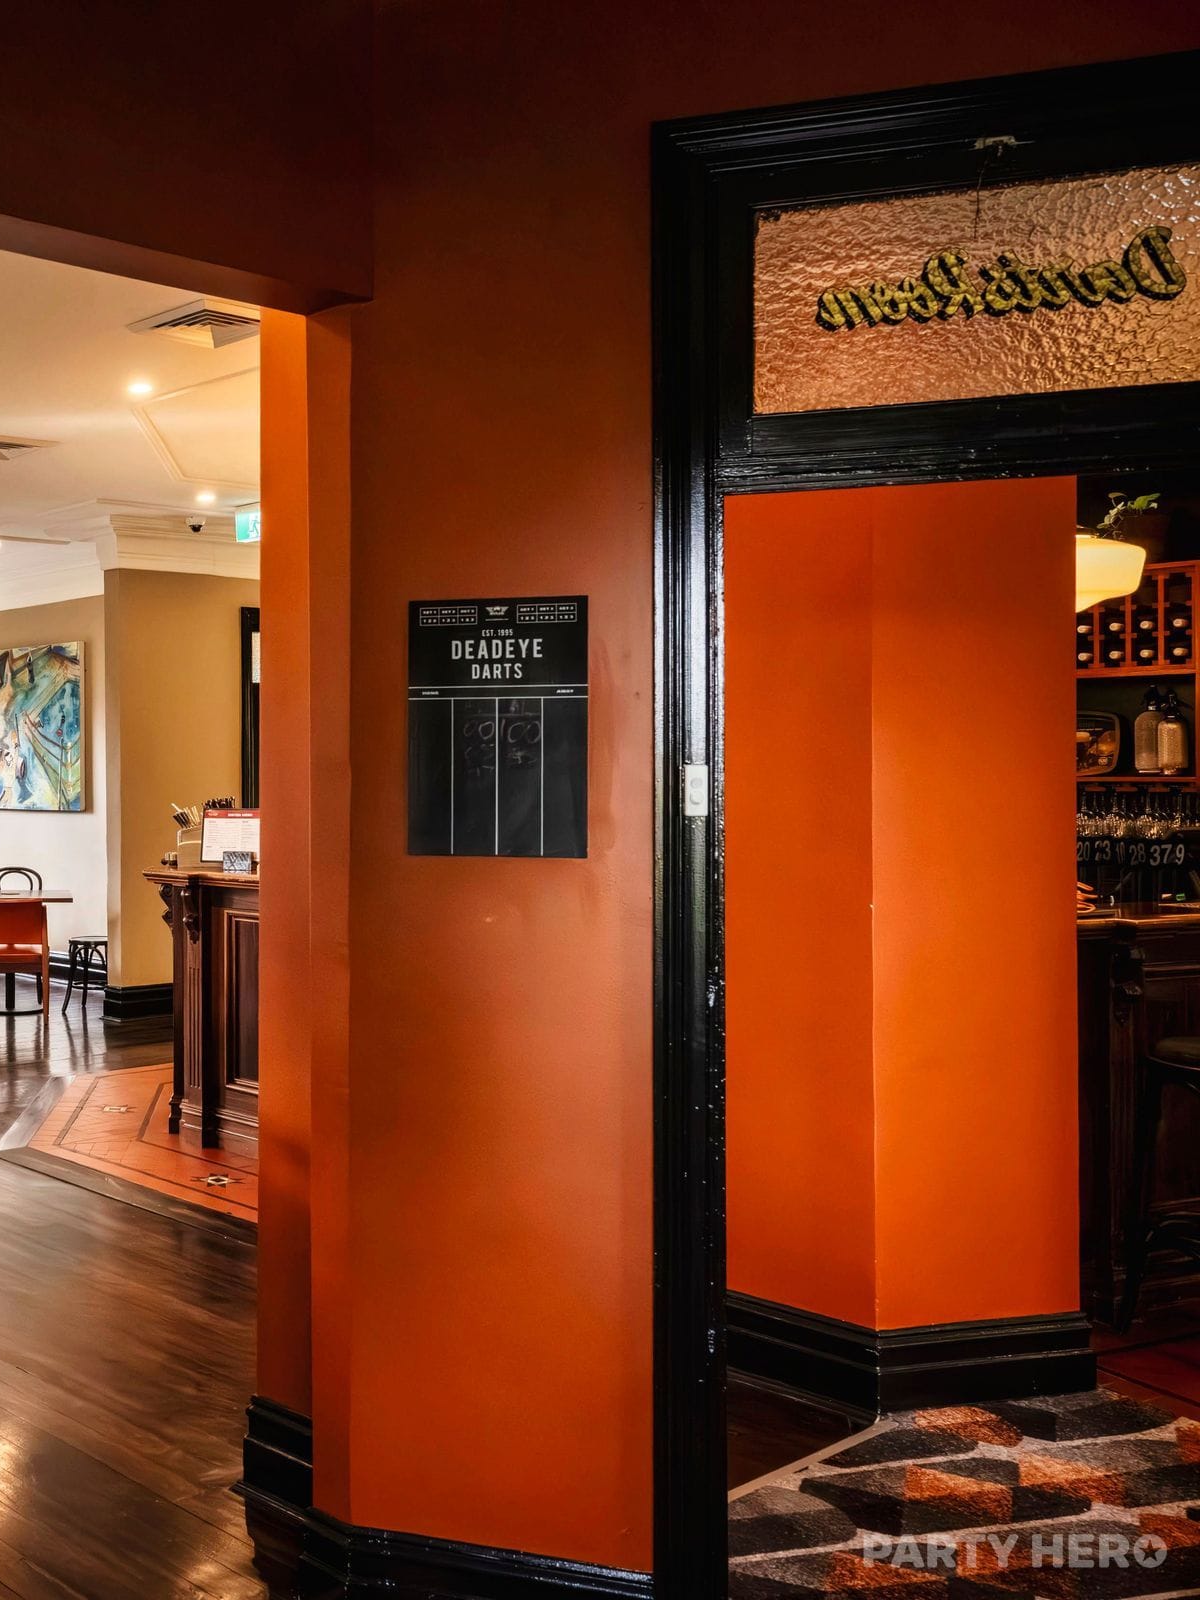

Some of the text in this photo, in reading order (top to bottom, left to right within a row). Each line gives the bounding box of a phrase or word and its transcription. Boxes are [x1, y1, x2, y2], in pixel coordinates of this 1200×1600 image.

[481, 628, 514, 637] EST. 1995
[451, 638, 543, 660] DEADEYE
[471, 663, 523, 680] DARTS
